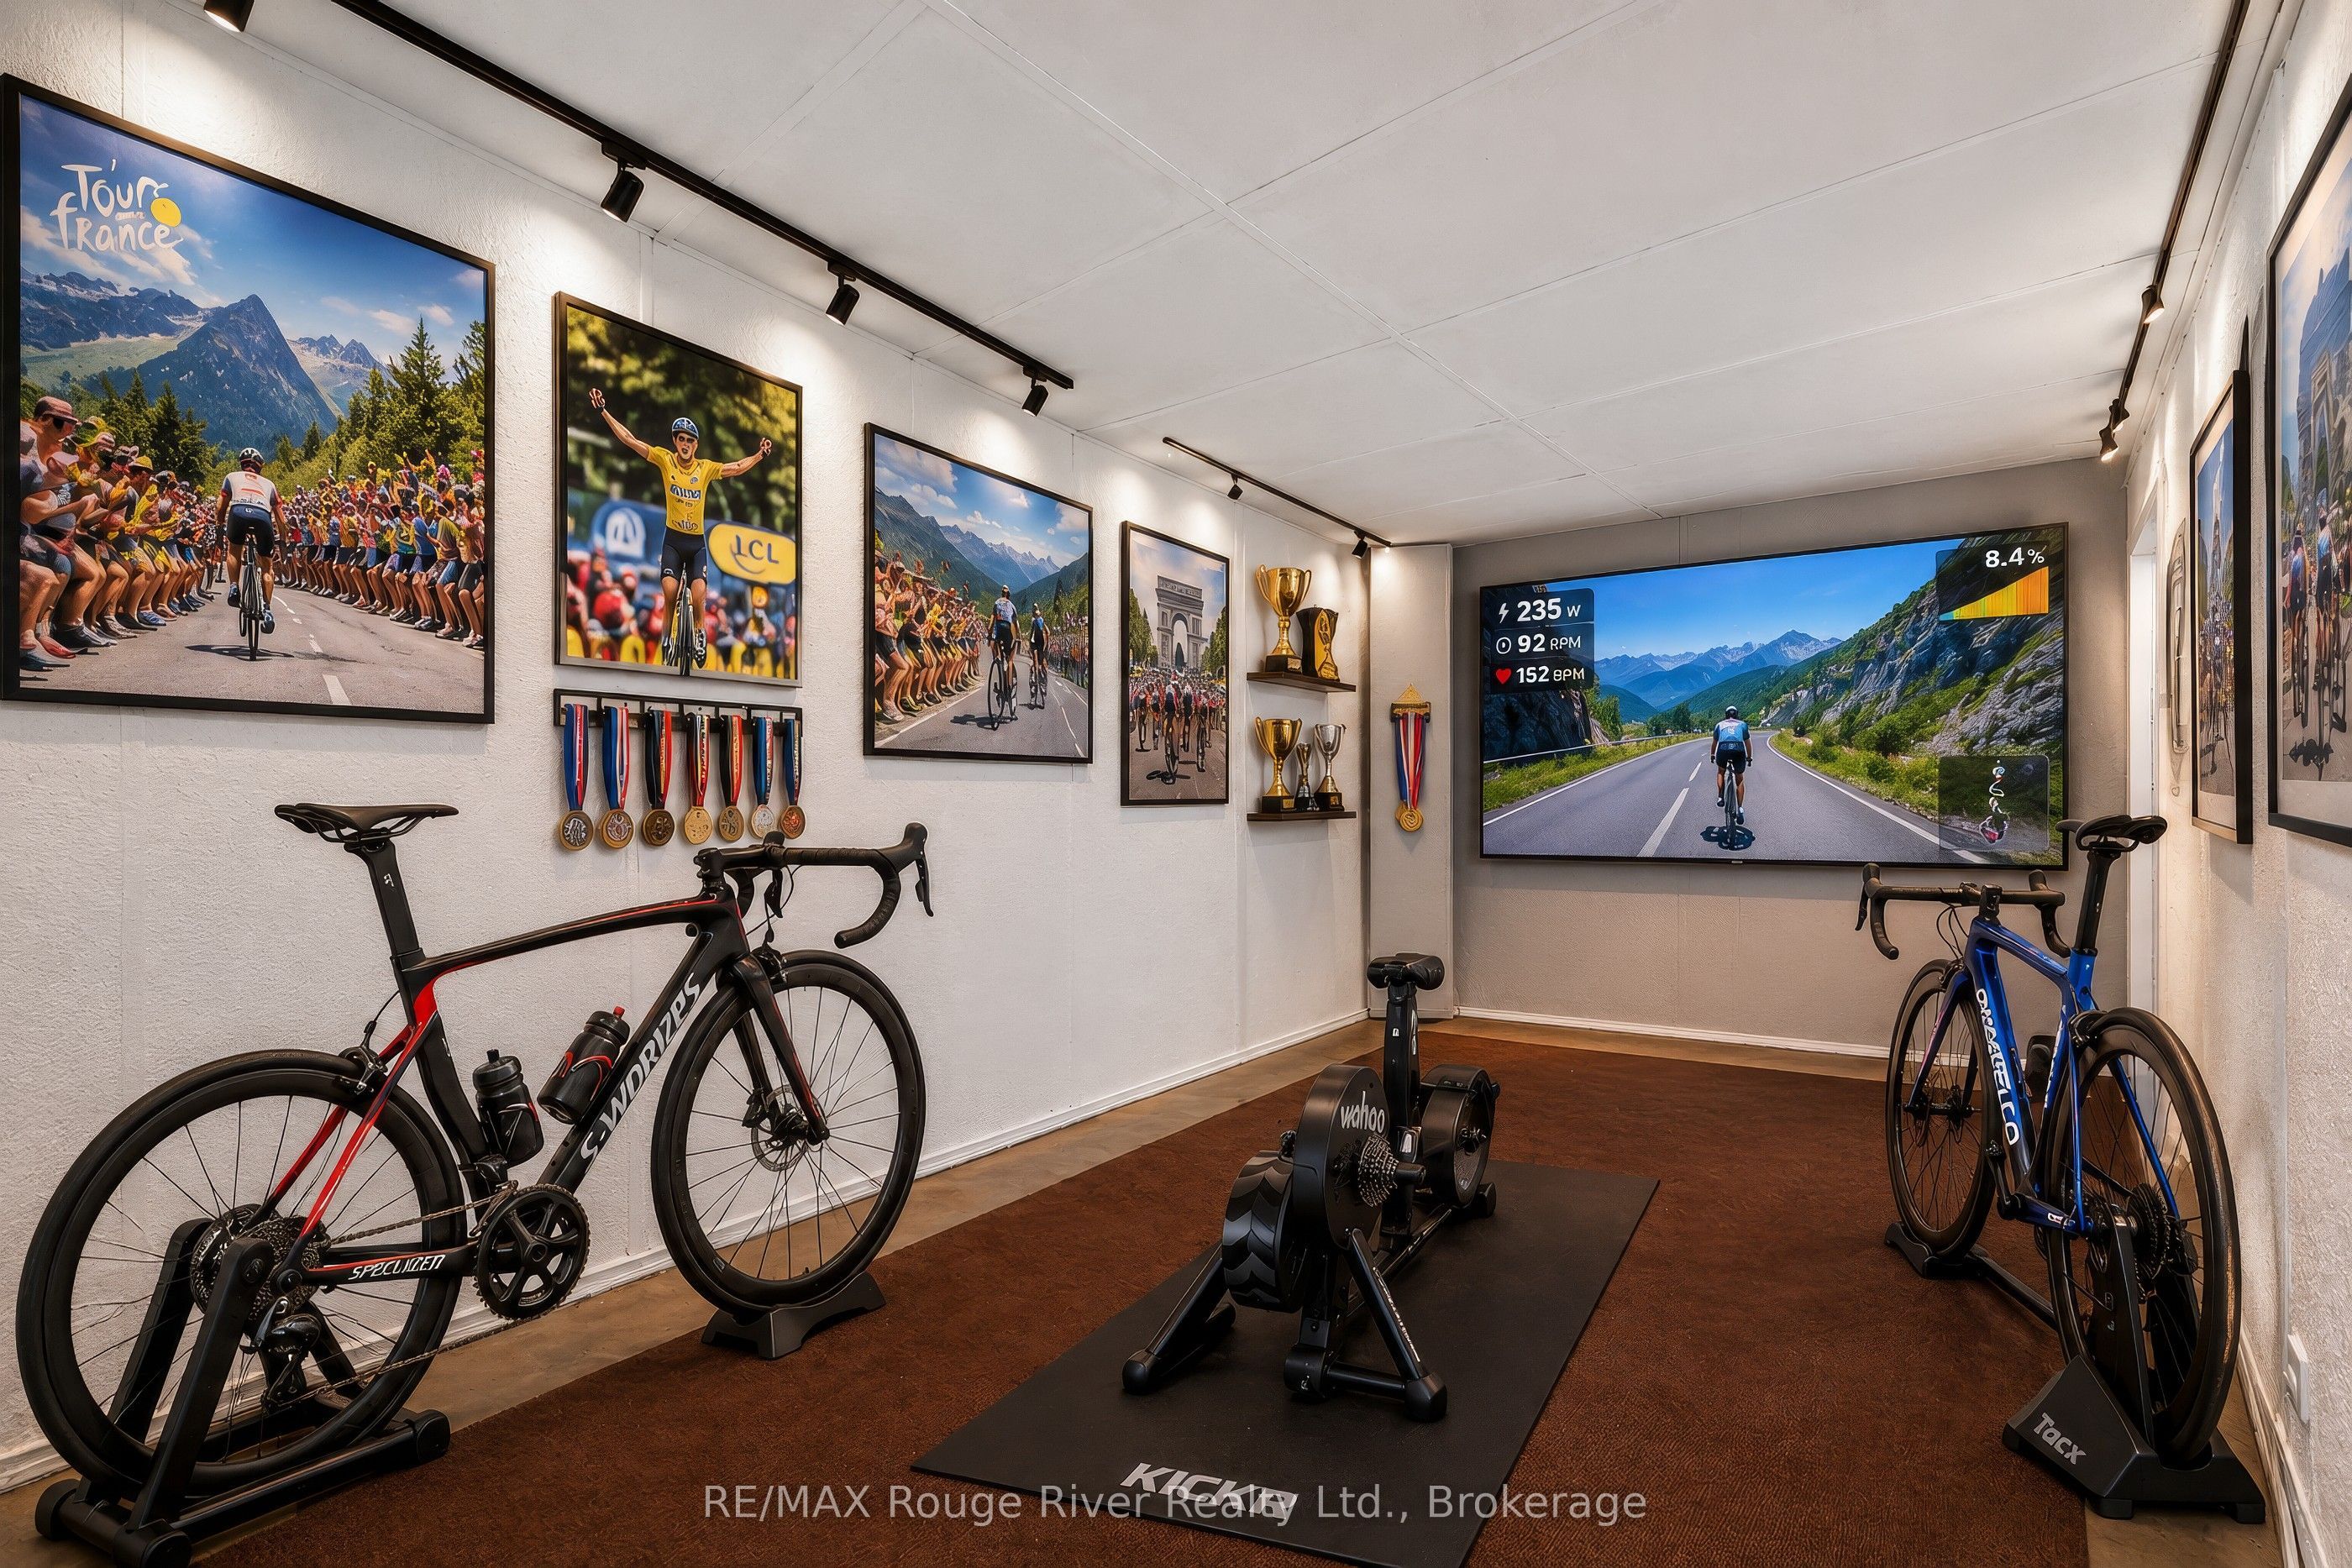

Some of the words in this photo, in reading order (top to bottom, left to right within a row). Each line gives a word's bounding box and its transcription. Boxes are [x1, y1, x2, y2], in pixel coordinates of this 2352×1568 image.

[734, 534, 780, 564] LCL
[1516, 597, 1562, 622] 235
[1517, 633, 1546, 653] 92
[1550, 635, 1581, 651] RPM
[1515, 665, 1550, 684] 152
[1553, 667, 1585, 682] BPM
[1340, 1090, 1385, 1134] wahoo
[2033, 1412, 2087, 1465] Tacx
[1120, 1462, 1298, 1520] KICKR
